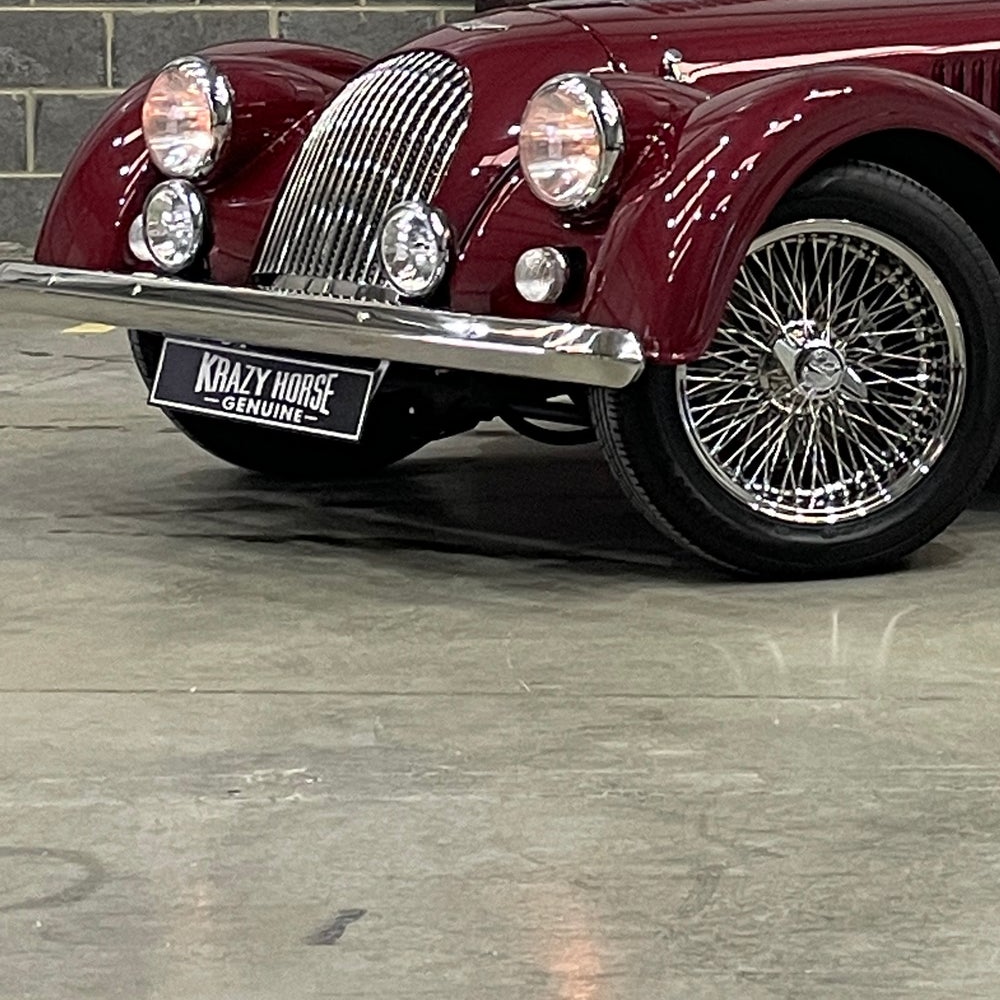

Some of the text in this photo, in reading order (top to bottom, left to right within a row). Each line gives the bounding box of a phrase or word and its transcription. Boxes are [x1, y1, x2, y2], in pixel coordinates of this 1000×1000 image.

[194, 351, 339, 416] KRAZY HORSE
[221, 396, 303, 423] GENUINE
